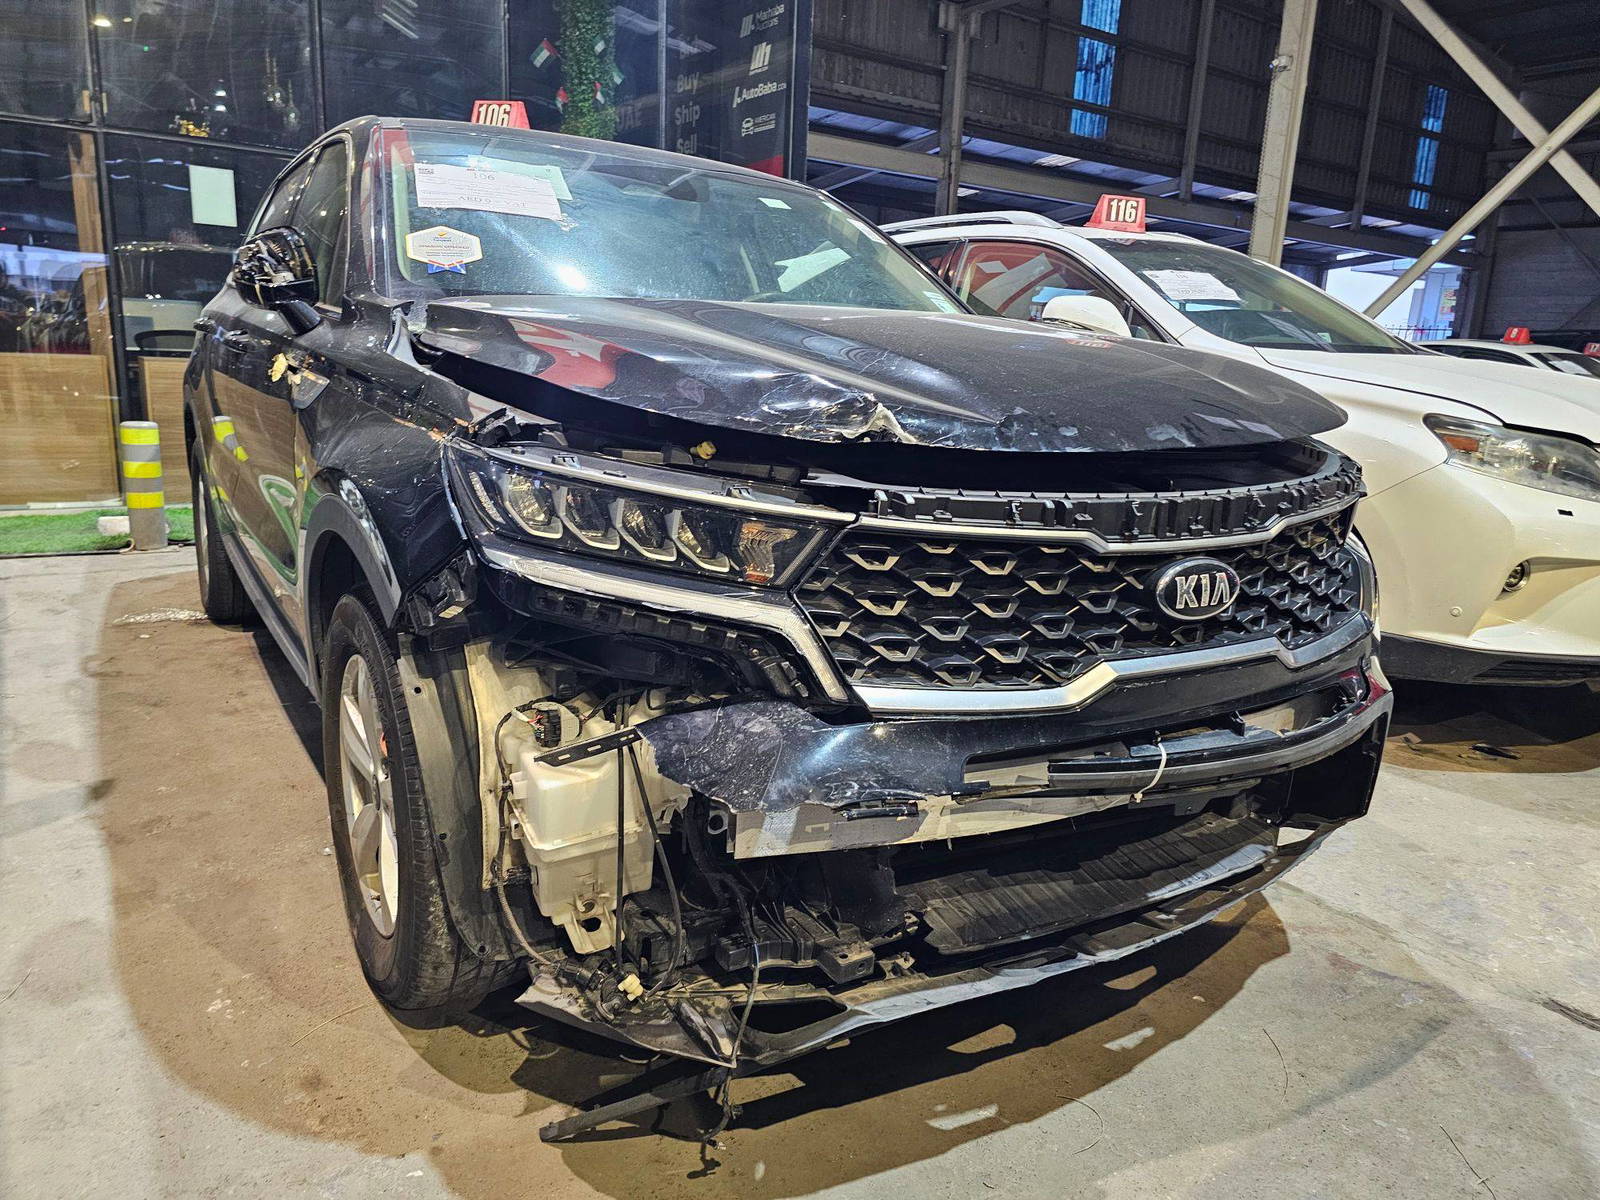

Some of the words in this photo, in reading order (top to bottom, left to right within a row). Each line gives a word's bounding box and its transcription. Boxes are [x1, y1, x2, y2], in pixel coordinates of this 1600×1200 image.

[677, 72, 700, 95] Buy
[478, 103, 512, 127] 106
[674, 101, 701, 127] Ship
[676, 133, 697, 154] Sell
[1110, 199, 1138, 223] 116
[1174, 571, 1231, 610] KIA
